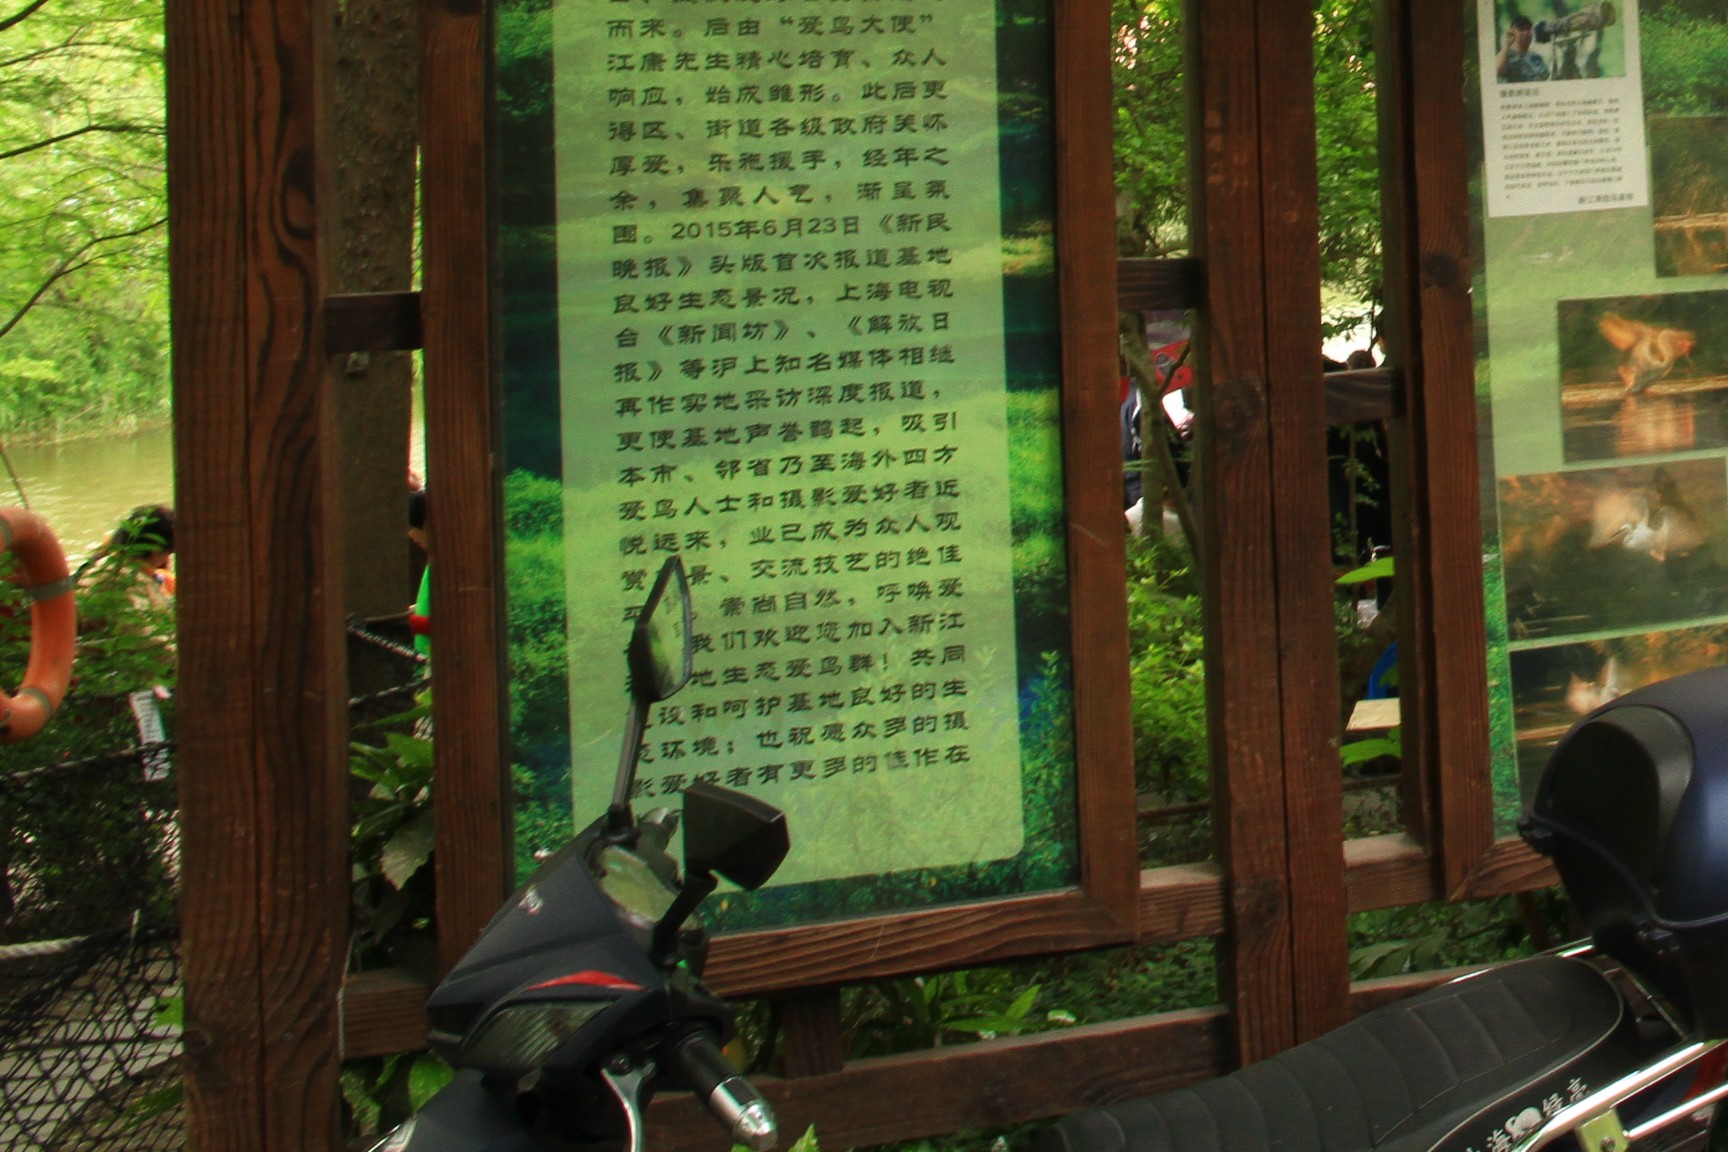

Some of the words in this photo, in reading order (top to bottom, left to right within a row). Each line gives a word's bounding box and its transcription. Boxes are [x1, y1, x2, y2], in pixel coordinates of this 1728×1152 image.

[612, 246, 952, 280] 晚报》头版首次报道基地
[614, 344, 955, 384] 报》等沪上知名媒体相继
[619, 478, 961, 521] 爱鸟人士和摄影爱好者近
[622, 544, 963, 592] 赏景、交流技艺的绝佳
[624, 611, 965, 656] 我们欢迎您加入新江
[625, 645, 966, 694] 地生态爱鸟群！共同
[628, 679, 968, 730] 设和呵护基地良好的生
